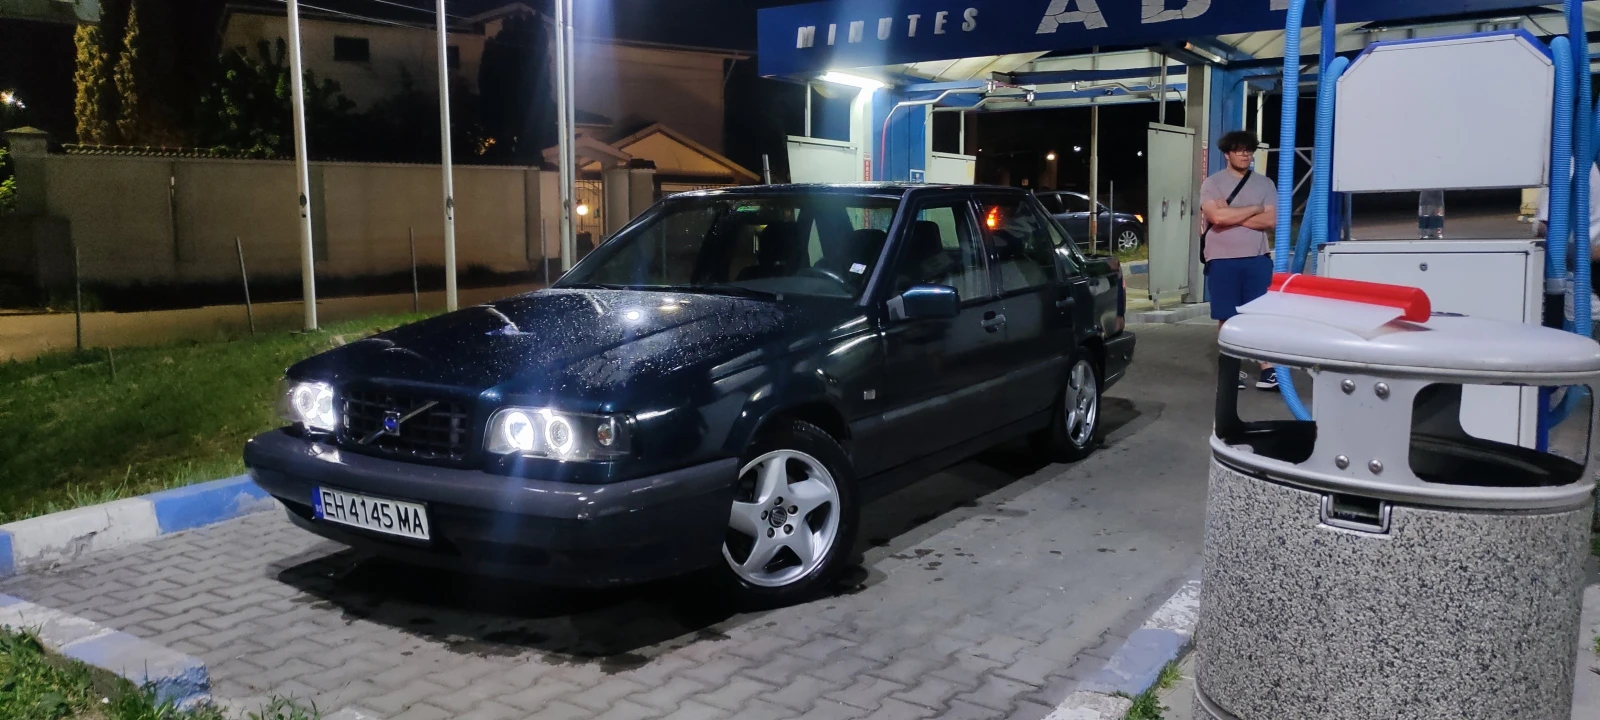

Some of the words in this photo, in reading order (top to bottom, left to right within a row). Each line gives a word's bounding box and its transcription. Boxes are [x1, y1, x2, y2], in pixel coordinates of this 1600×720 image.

[796, 8, 979, 49] MINUTES
[322, 491, 347, 521] EH
[350, 498, 394, 529] 4145
[395, 504, 425, 535] MA
